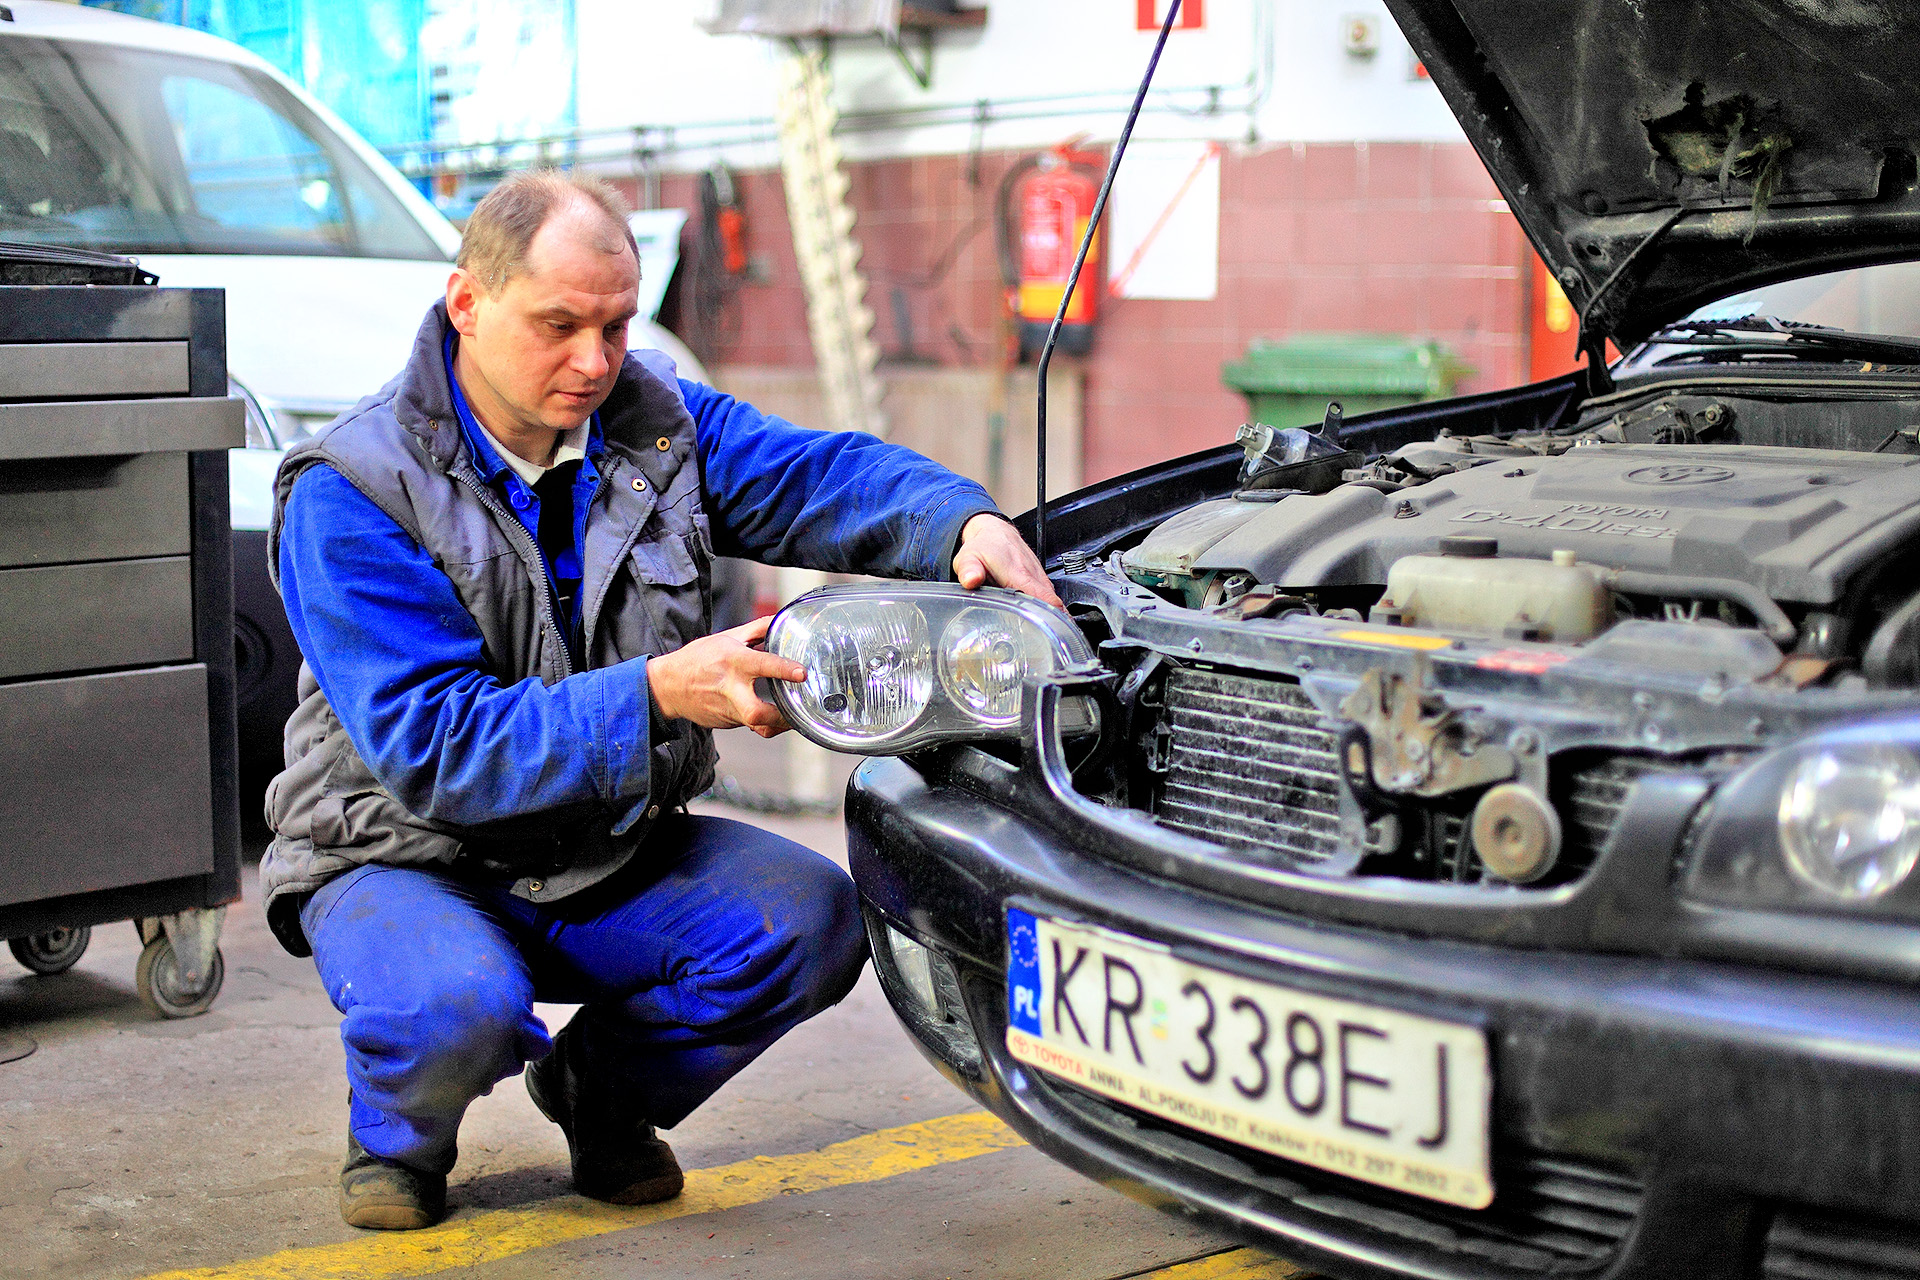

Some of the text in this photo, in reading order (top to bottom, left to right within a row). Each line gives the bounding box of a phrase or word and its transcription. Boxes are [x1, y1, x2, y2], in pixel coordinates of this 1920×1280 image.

[1557, 503, 1670, 520] TOYOTA
[1014, 985, 1038, 1019] PL
[1051, 938, 1450, 1149] KR 338EJ
[1033, 1044, 1084, 1077] TOYOTA
[1089, 1067, 1125, 1093] ANWA
